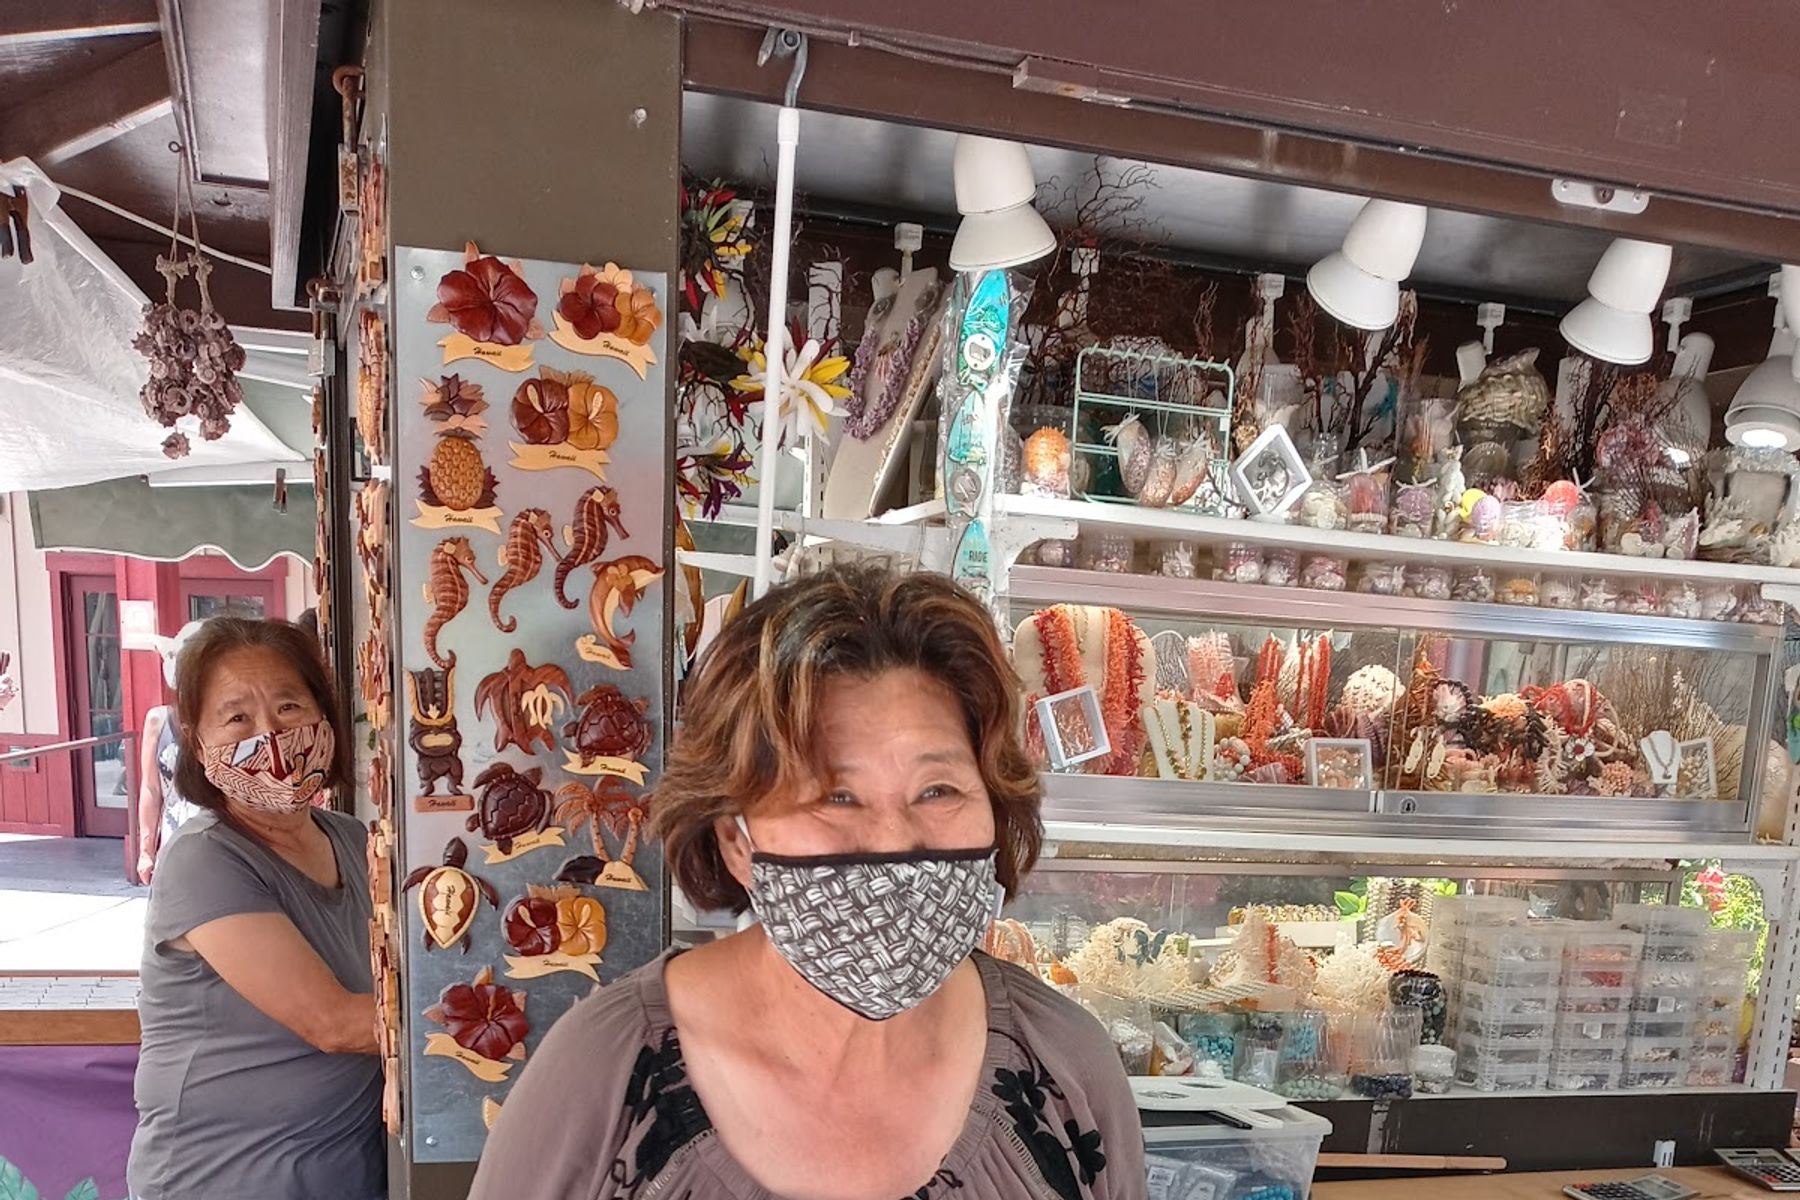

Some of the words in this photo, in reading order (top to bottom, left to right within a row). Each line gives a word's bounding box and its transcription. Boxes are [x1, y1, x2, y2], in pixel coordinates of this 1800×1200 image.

[474, 346, 502, 356] Hawaii
[603, 340, 629, 356] Hawaii
[549, 450, 576, 461] Hawaii
[444, 514, 473, 523] Hawaii
[600, 763, 625, 774] Hawaii
[428, 799, 456, 807] Hawaii
[514, 838, 540, 849] Hawaii
[604, 873, 631, 883] Hawaii
[446, 885, 456, 915] Hawaii
[543, 959, 568, 967] Hawaii
[455, 1051, 480, 1065] Hawaii
